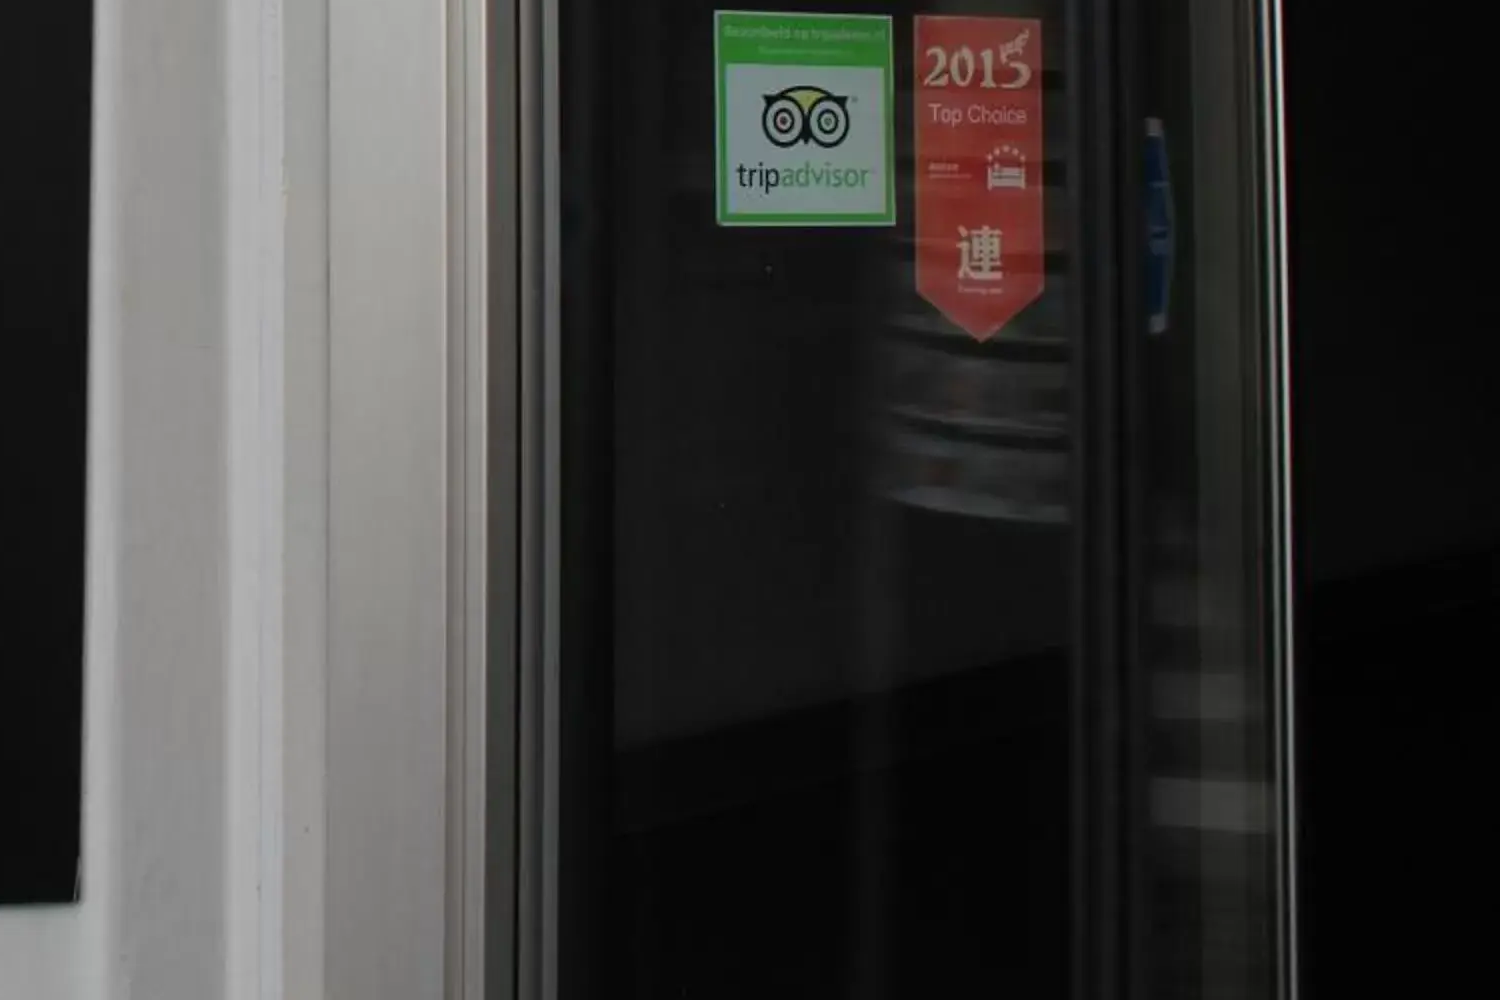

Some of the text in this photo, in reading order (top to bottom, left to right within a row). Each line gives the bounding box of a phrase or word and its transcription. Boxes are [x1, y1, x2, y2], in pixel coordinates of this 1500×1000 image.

[923, 34, 1032, 89] 2015
[928, 103, 1028, 126] Top Choice
[736, 161, 869, 194] tripadvisor
